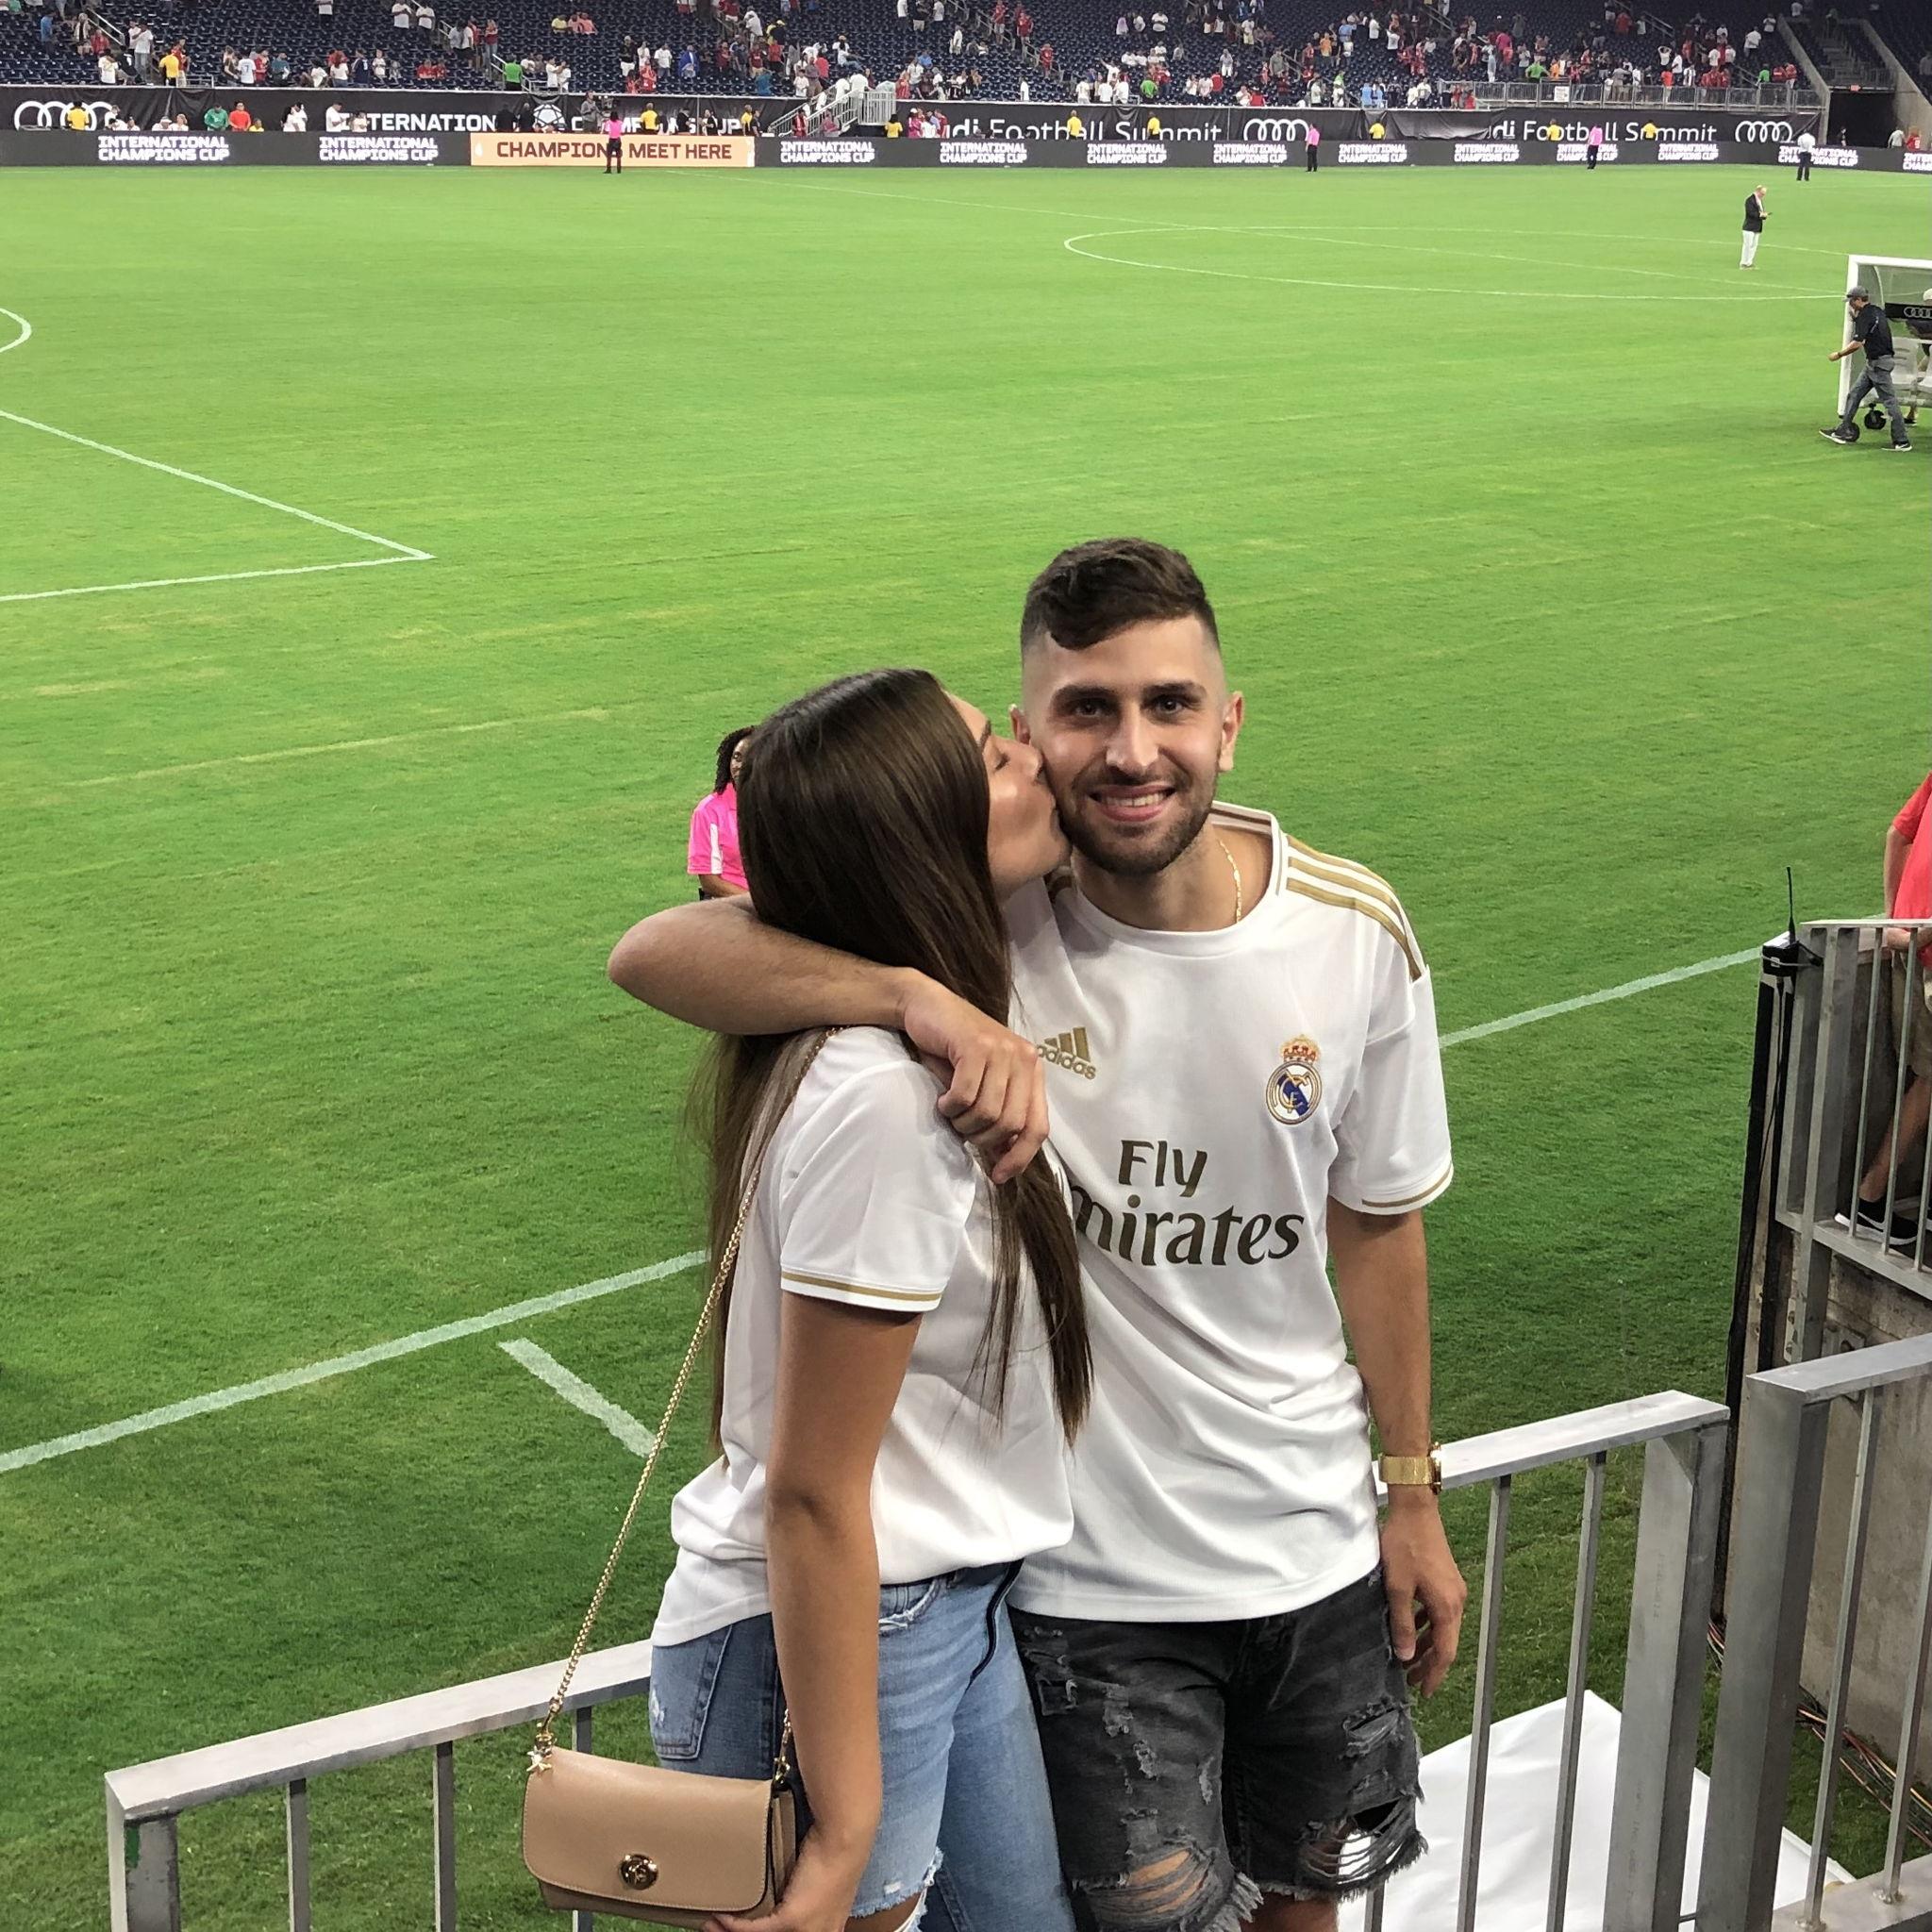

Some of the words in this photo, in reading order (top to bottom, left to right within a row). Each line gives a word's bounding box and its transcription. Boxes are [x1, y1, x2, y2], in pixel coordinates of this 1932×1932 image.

[1523, 120, 1619, 142] Fotbll
[1624, 122, 1718, 142] Smmit
[98, 136, 228, 148] INTERNATIONAL
[319, 137, 438, 149] INTERNATIONAL
[780, 142, 874, 152] INTERNATIONAL
[940, 142, 1027, 153] INTERNATIONAL
[98, 148, 192, 160] CHAMPIONS
[199, 148, 229, 160] CUP
[319, 148, 409, 160] CHAMPIONS
[411, 148, 439, 160] CUP
[496, 141, 623, 158] CHAMPION
[628, 142, 681, 158] MEET
[685, 143, 732, 159] HERE
[1087, 143, 1167, 154] INTERNATIONAL
[1213, 143, 1287, 154] INTERNATIONAL
[1339, 143, 1407, 154] INTERNATIONAL
[780, 152, 851, 163] CHAMPIONS
[853, 152, 875, 163] CUP
[940, 153, 1006, 163] CHAMPIONS
[1008, 153, 1027, 163] CUP
[1087, 153, 1148, 163] CHAMPIONS
[1148, 153, 1167, 164] CUP
[1213, 154, 1269, 163] CHAMPIONS
[1269, 154, 1288, 163] CUP
[1339, 154, 1390, 162] CHAMPIONS
[1391, 154, 1407, 162] CUP
[1504, 154, 1520, 162] CUP
[1603, 153, 1618, 161] CUP
[1839, 157, 1858, 167] CUP
[1037, 1044, 1096, 1079] adidas
[1119, 1140, 1208, 1197] Fly
[1071, 1185, 1306, 1266] mirates
